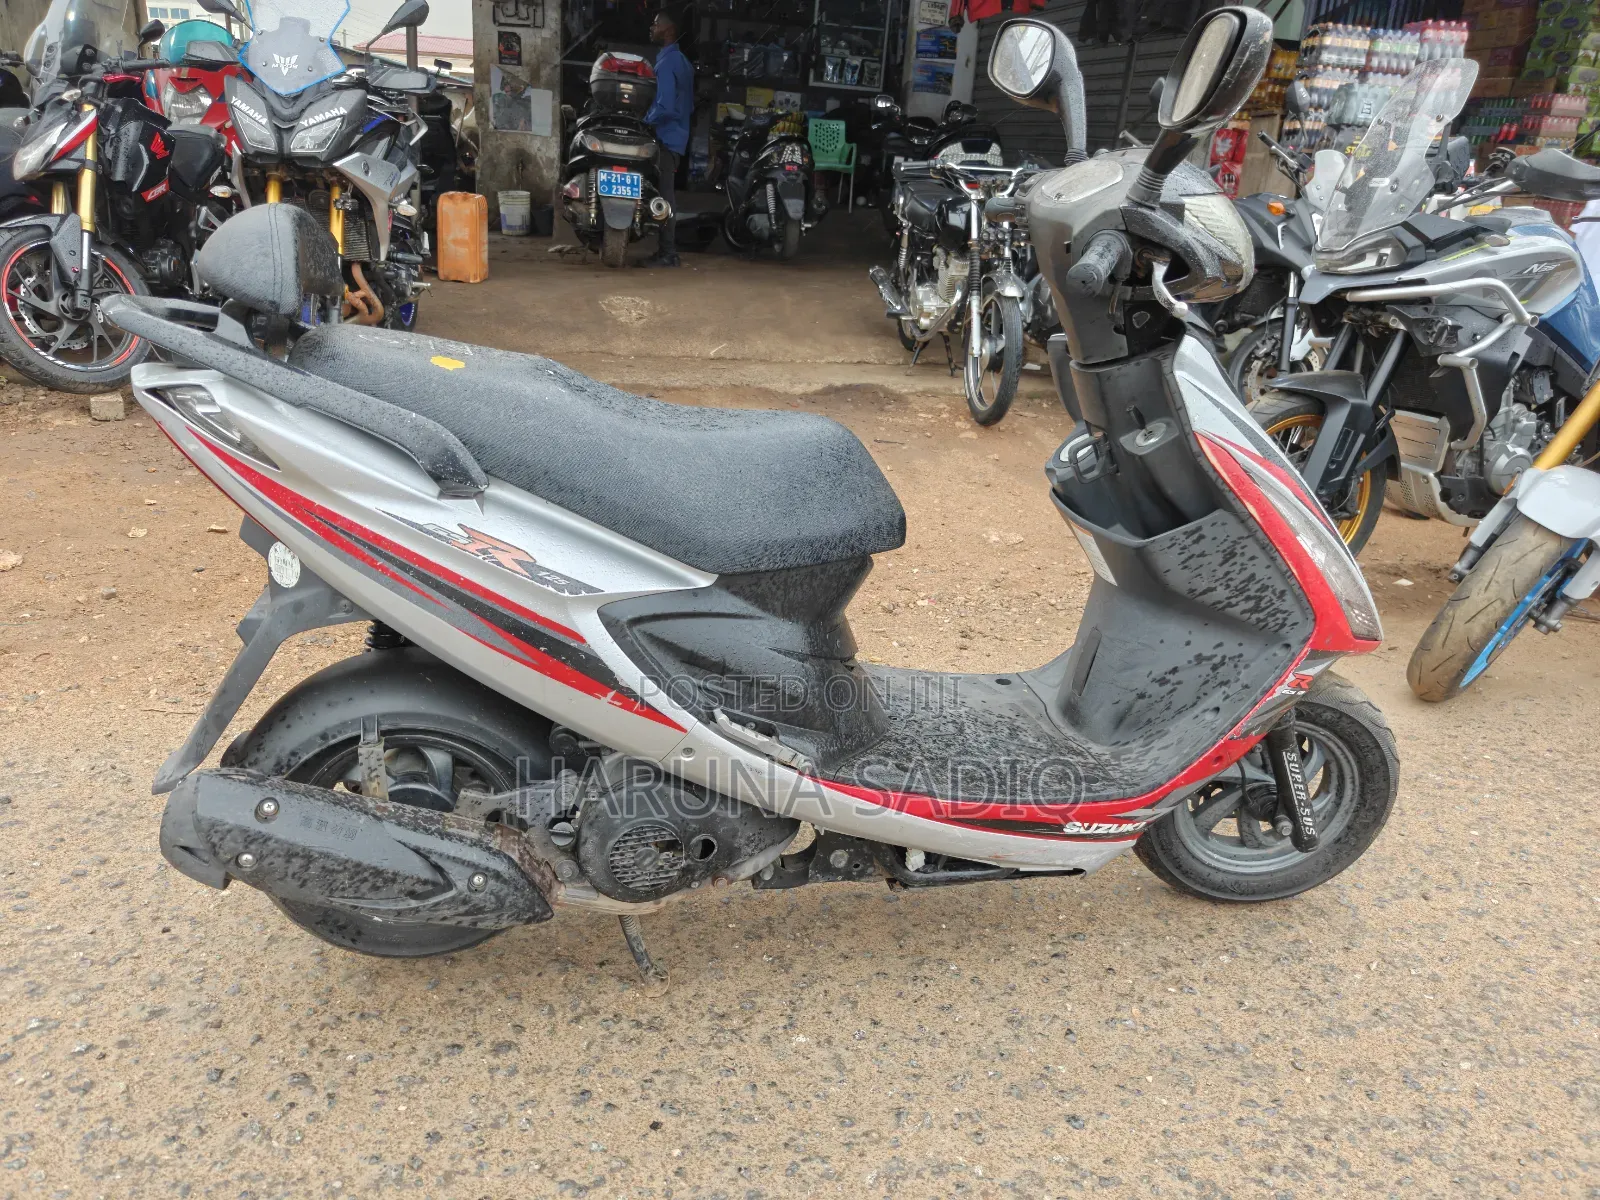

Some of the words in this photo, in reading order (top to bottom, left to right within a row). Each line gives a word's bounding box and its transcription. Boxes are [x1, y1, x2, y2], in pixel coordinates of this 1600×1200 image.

[230, 95, 269, 126] YAMAHA
[299, 106, 348, 127] YAMAHA
[611, 185, 632, 196] 2355
[537, 571, 571, 586] 125
[1063, 821, 1147, 834] SUZUKI
